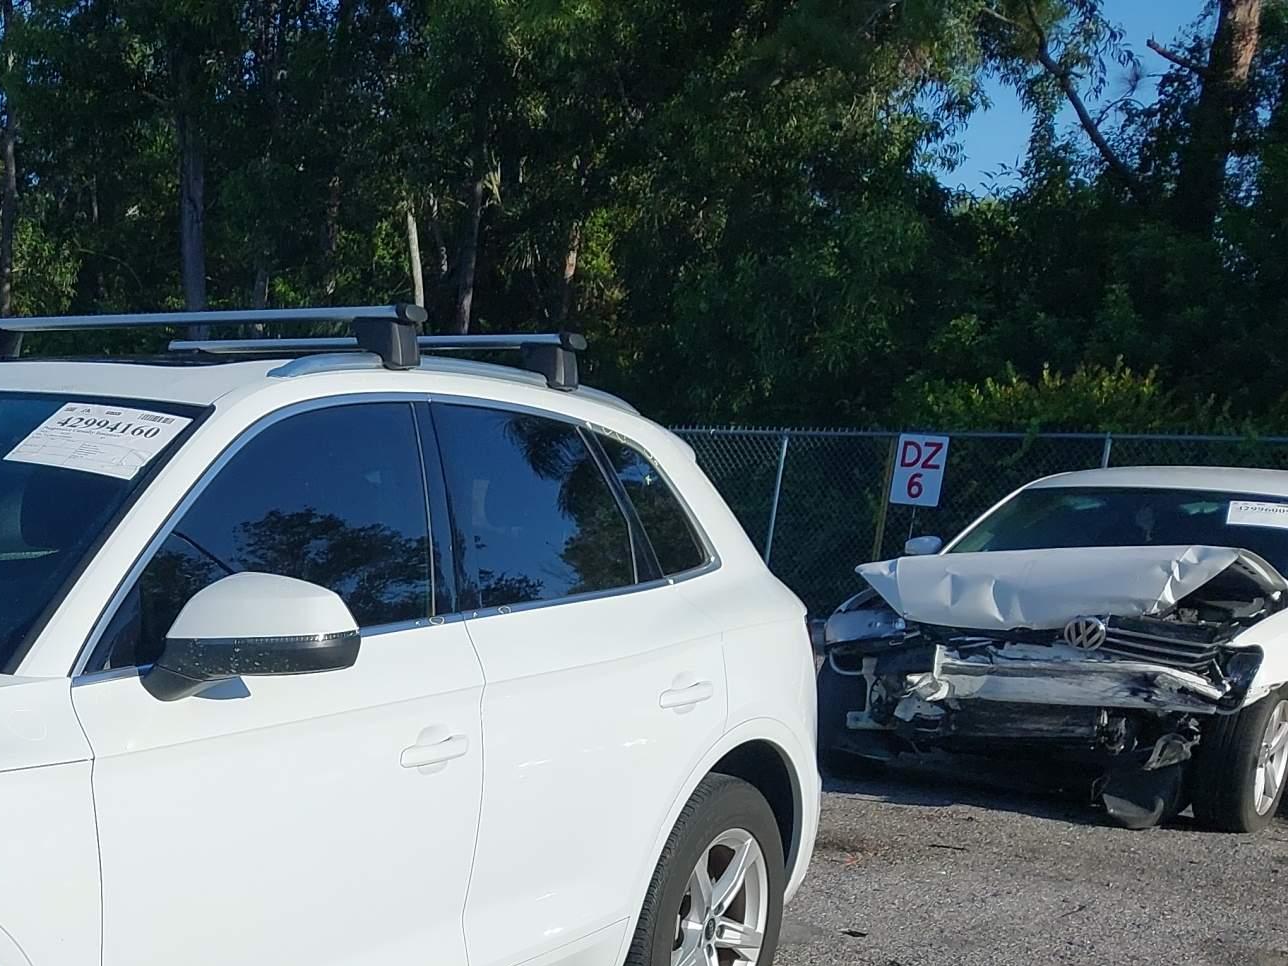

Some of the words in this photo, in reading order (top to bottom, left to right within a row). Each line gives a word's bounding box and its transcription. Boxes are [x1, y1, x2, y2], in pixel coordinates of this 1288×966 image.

[57, 416, 161, 438] 42994160
[900, 440, 944, 470] DZ
[906, 472, 924, 499] 6
